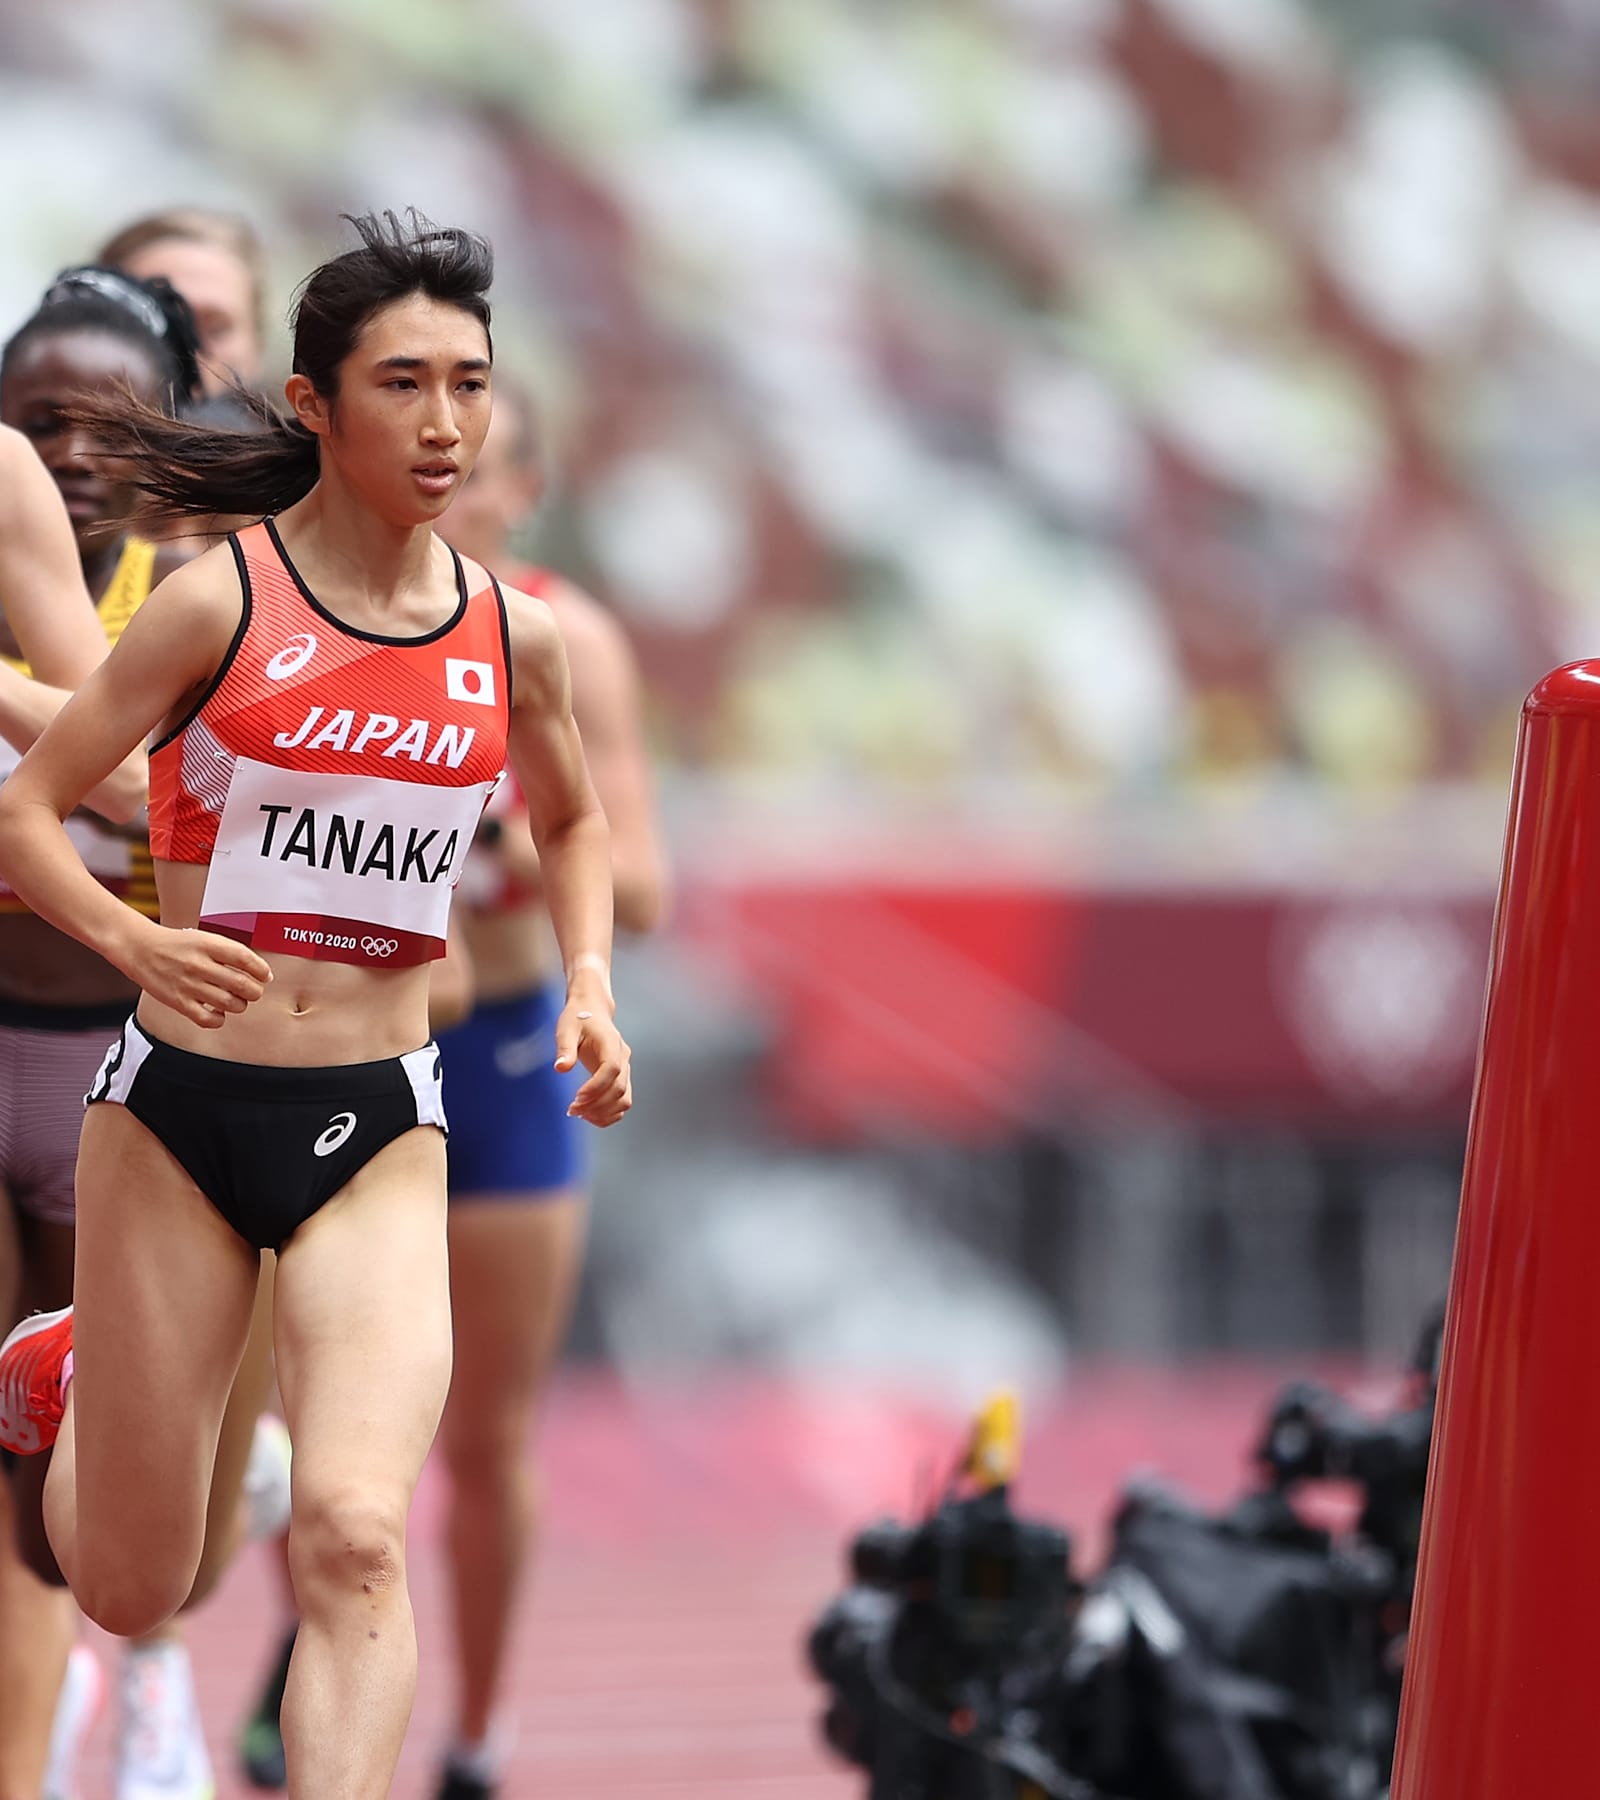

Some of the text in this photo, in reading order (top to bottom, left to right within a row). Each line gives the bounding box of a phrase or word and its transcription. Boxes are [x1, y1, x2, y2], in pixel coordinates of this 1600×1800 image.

[273, 705, 475, 769] JAPAN
[258, 803, 459, 883] TANAKA
[283, 926, 357, 949] TOKYO 2020
